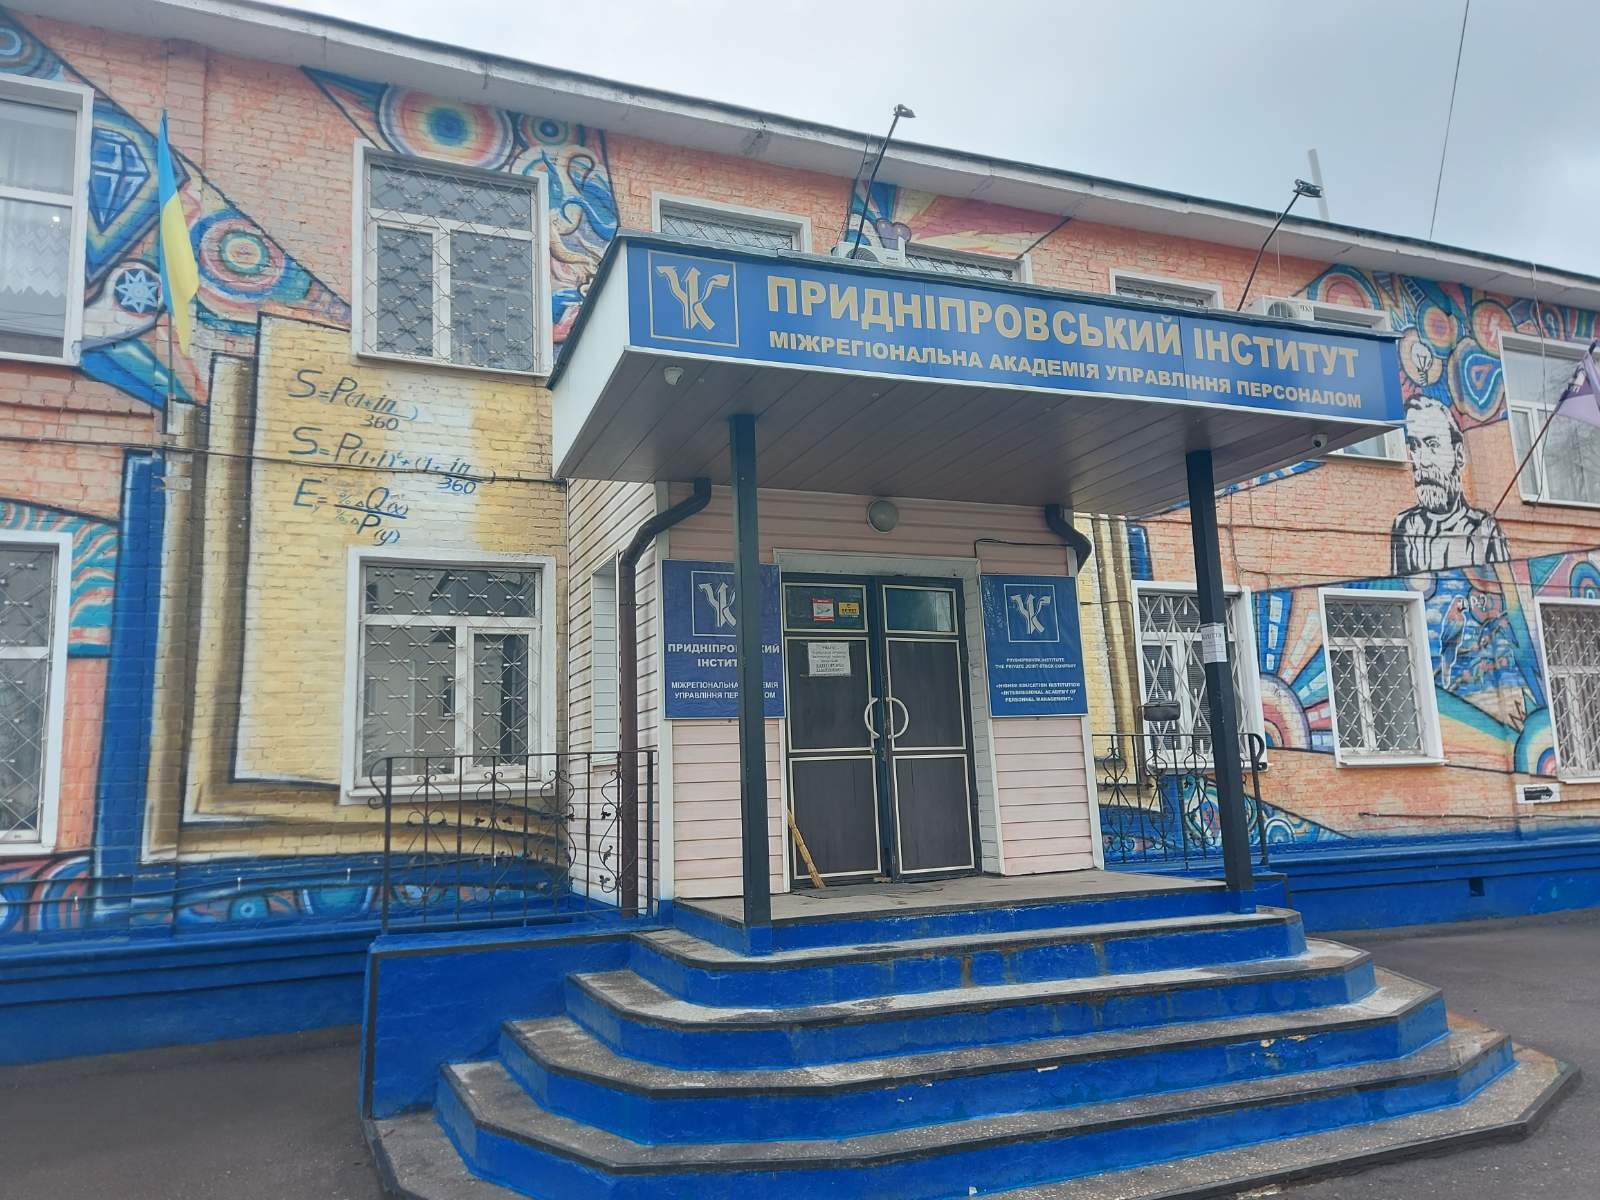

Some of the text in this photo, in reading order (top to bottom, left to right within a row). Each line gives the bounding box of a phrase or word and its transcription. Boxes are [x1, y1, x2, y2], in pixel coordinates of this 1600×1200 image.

[767, 275, 1359, 378] ПРИДНІПРОВСЬКИЙ ІНСТИТУТ
[769, 330, 1361, 408] МІЖРЕГІОНАЛЬНА АКАДЕМІЯ УПРАВЛІННЯ ПЕРСОНАЛОМ
[359, 414, 399, 431] 360
[436, 474, 477, 495] 360
[671, 681, 739, 689] МІЖРЕГІОНАЛЬНА
[674, 691, 723, 699] УПРАВЛІННЯ
